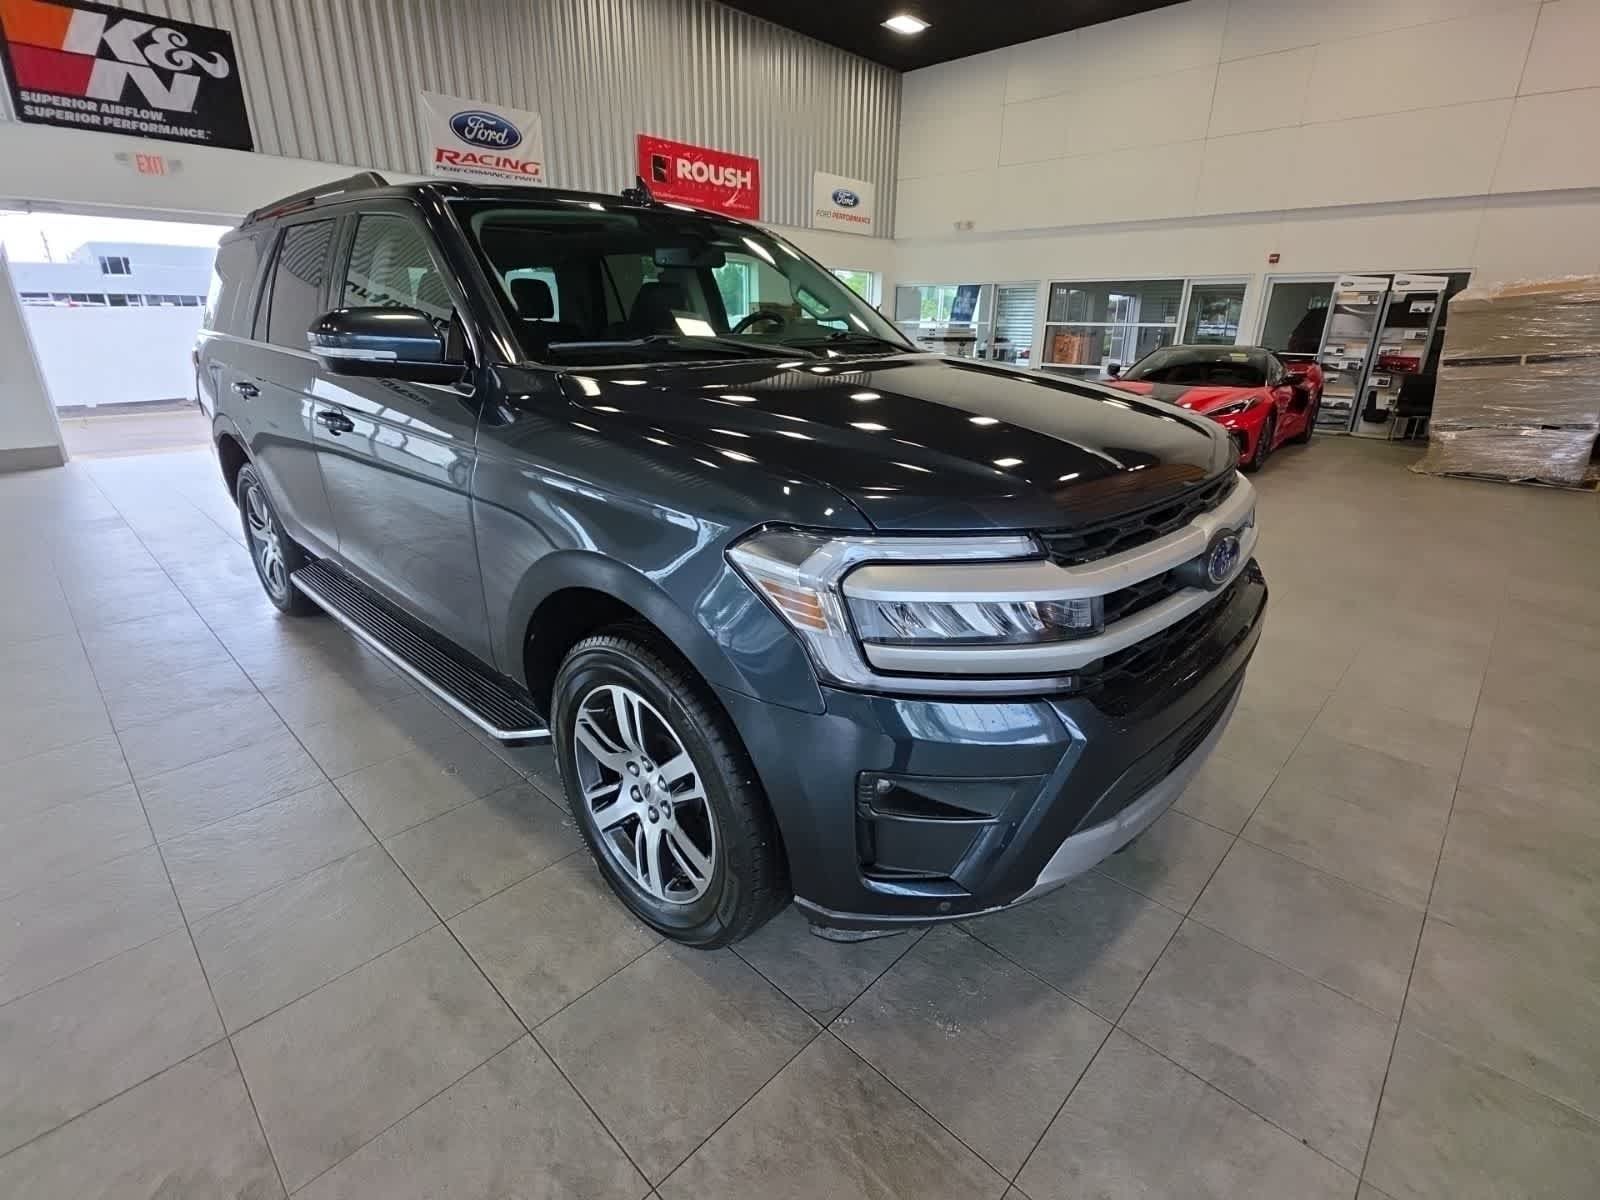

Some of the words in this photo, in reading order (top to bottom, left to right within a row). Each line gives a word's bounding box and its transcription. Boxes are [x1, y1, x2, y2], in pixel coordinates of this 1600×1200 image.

[62, 8, 230, 113] K&N
[20, 91, 97, 112] SUPERIOR
[100, 103, 166, 122] AIRFLOW.
[24, 105, 101, 126] SUPERIOR
[465, 115, 509, 145] Ford
[135, 154, 166, 175] EXIT
[435, 148, 541, 176] RACING
[436, 165, 512, 180] PERFORMANCE
[676, 157, 752, 190] ROUSH
[837, 191, 855, 206] Ford
[832, 211, 871, 224] PERFORMANCE
